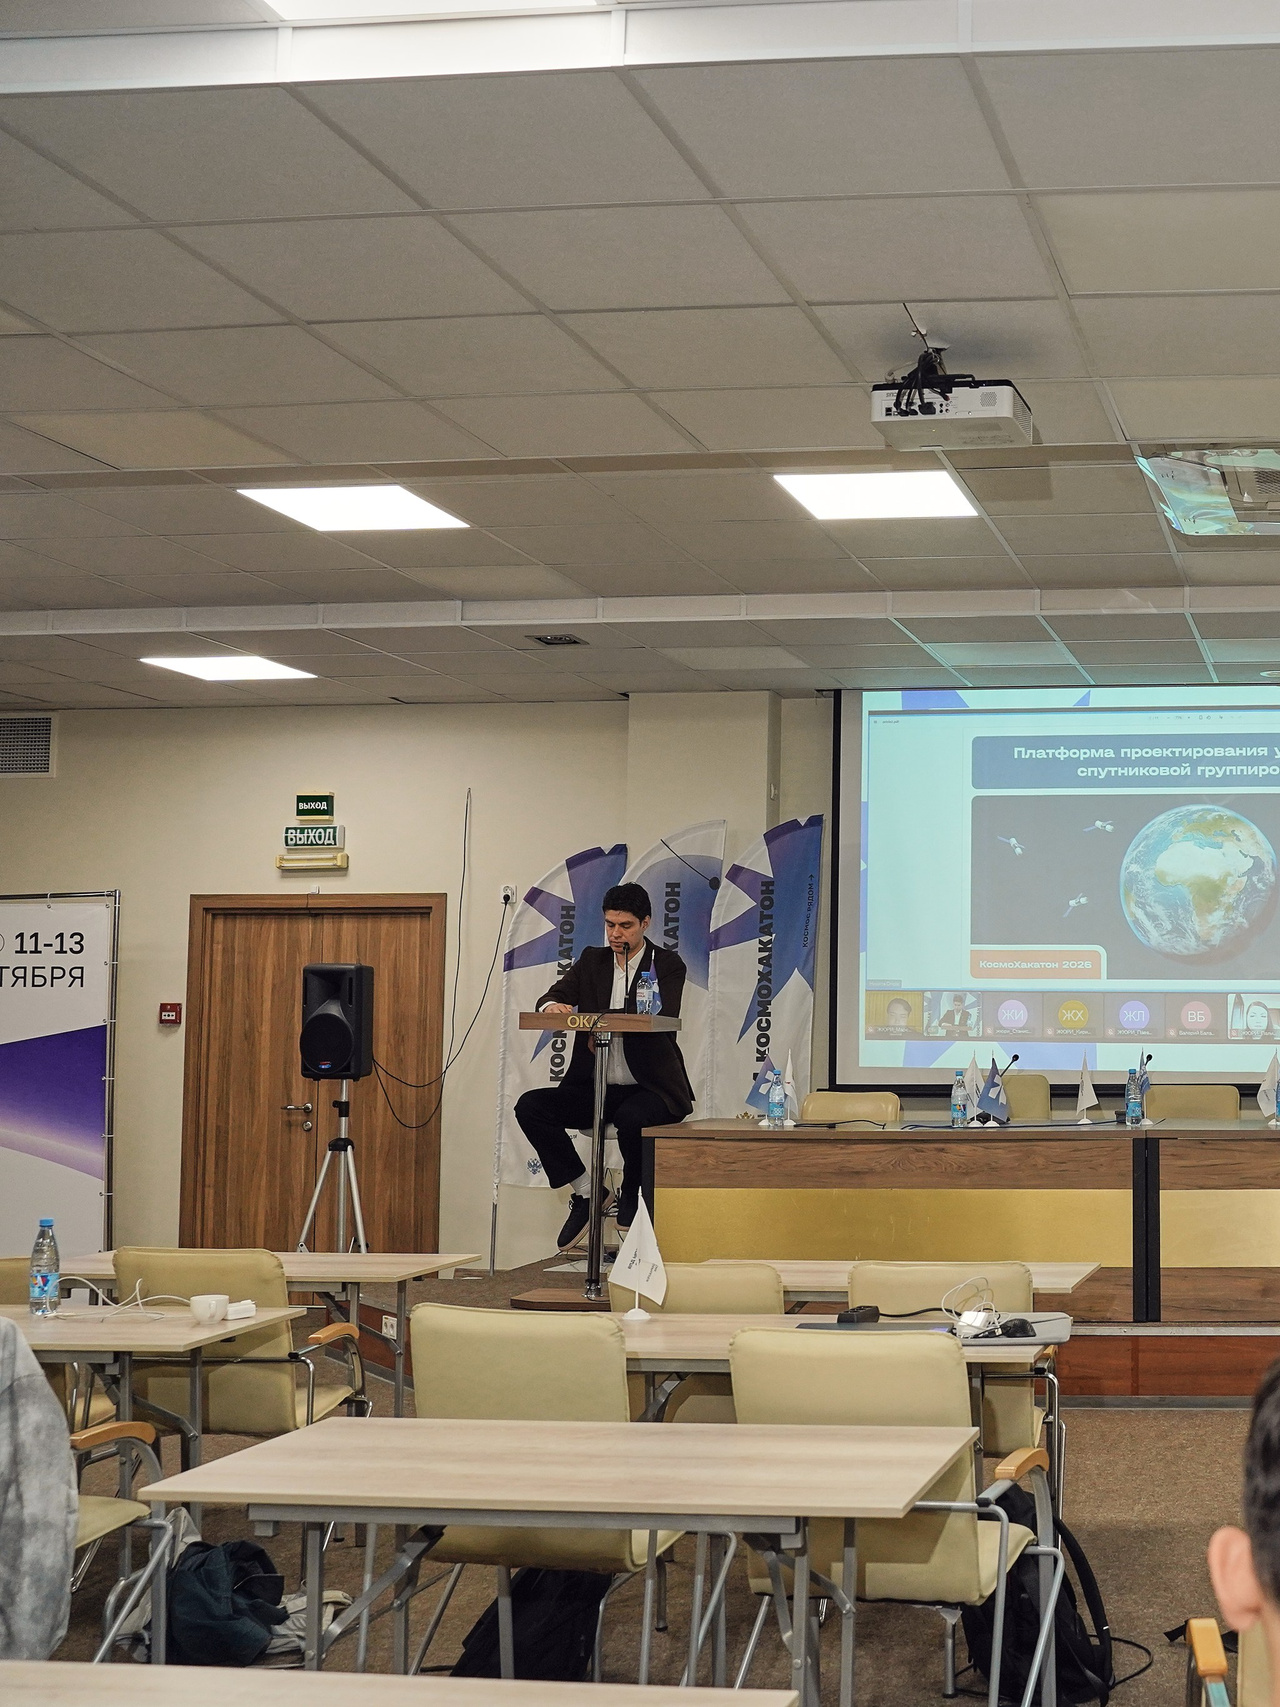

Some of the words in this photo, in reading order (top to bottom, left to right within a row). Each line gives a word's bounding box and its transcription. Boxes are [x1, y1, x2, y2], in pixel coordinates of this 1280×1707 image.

[1013, 746, 1115, 760] Платформа
[1120, 746, 1268, 760] проектирования
[1077, 763, 1191, 778] спутниковой
[298, 802, 327, 810] ВЫХОД
[288, 828, 334, 845] ВЫХОД
[15, 932, 84, 954] 11-13
[978, 960, 1059, 970] КосмоХакатон
[1062, 960, 1092, 970] 2026
[755, 880, 775, 1063] КОСМОХАКАТОН
[1002, 1009, 1024, 1020] ЖИ
[1062, 1010, 1084, 1021] ЖХ
[1123, 1010, 1145, 1021] ЖЛ
[1188, 1011, 1205, 1022] ВБ
